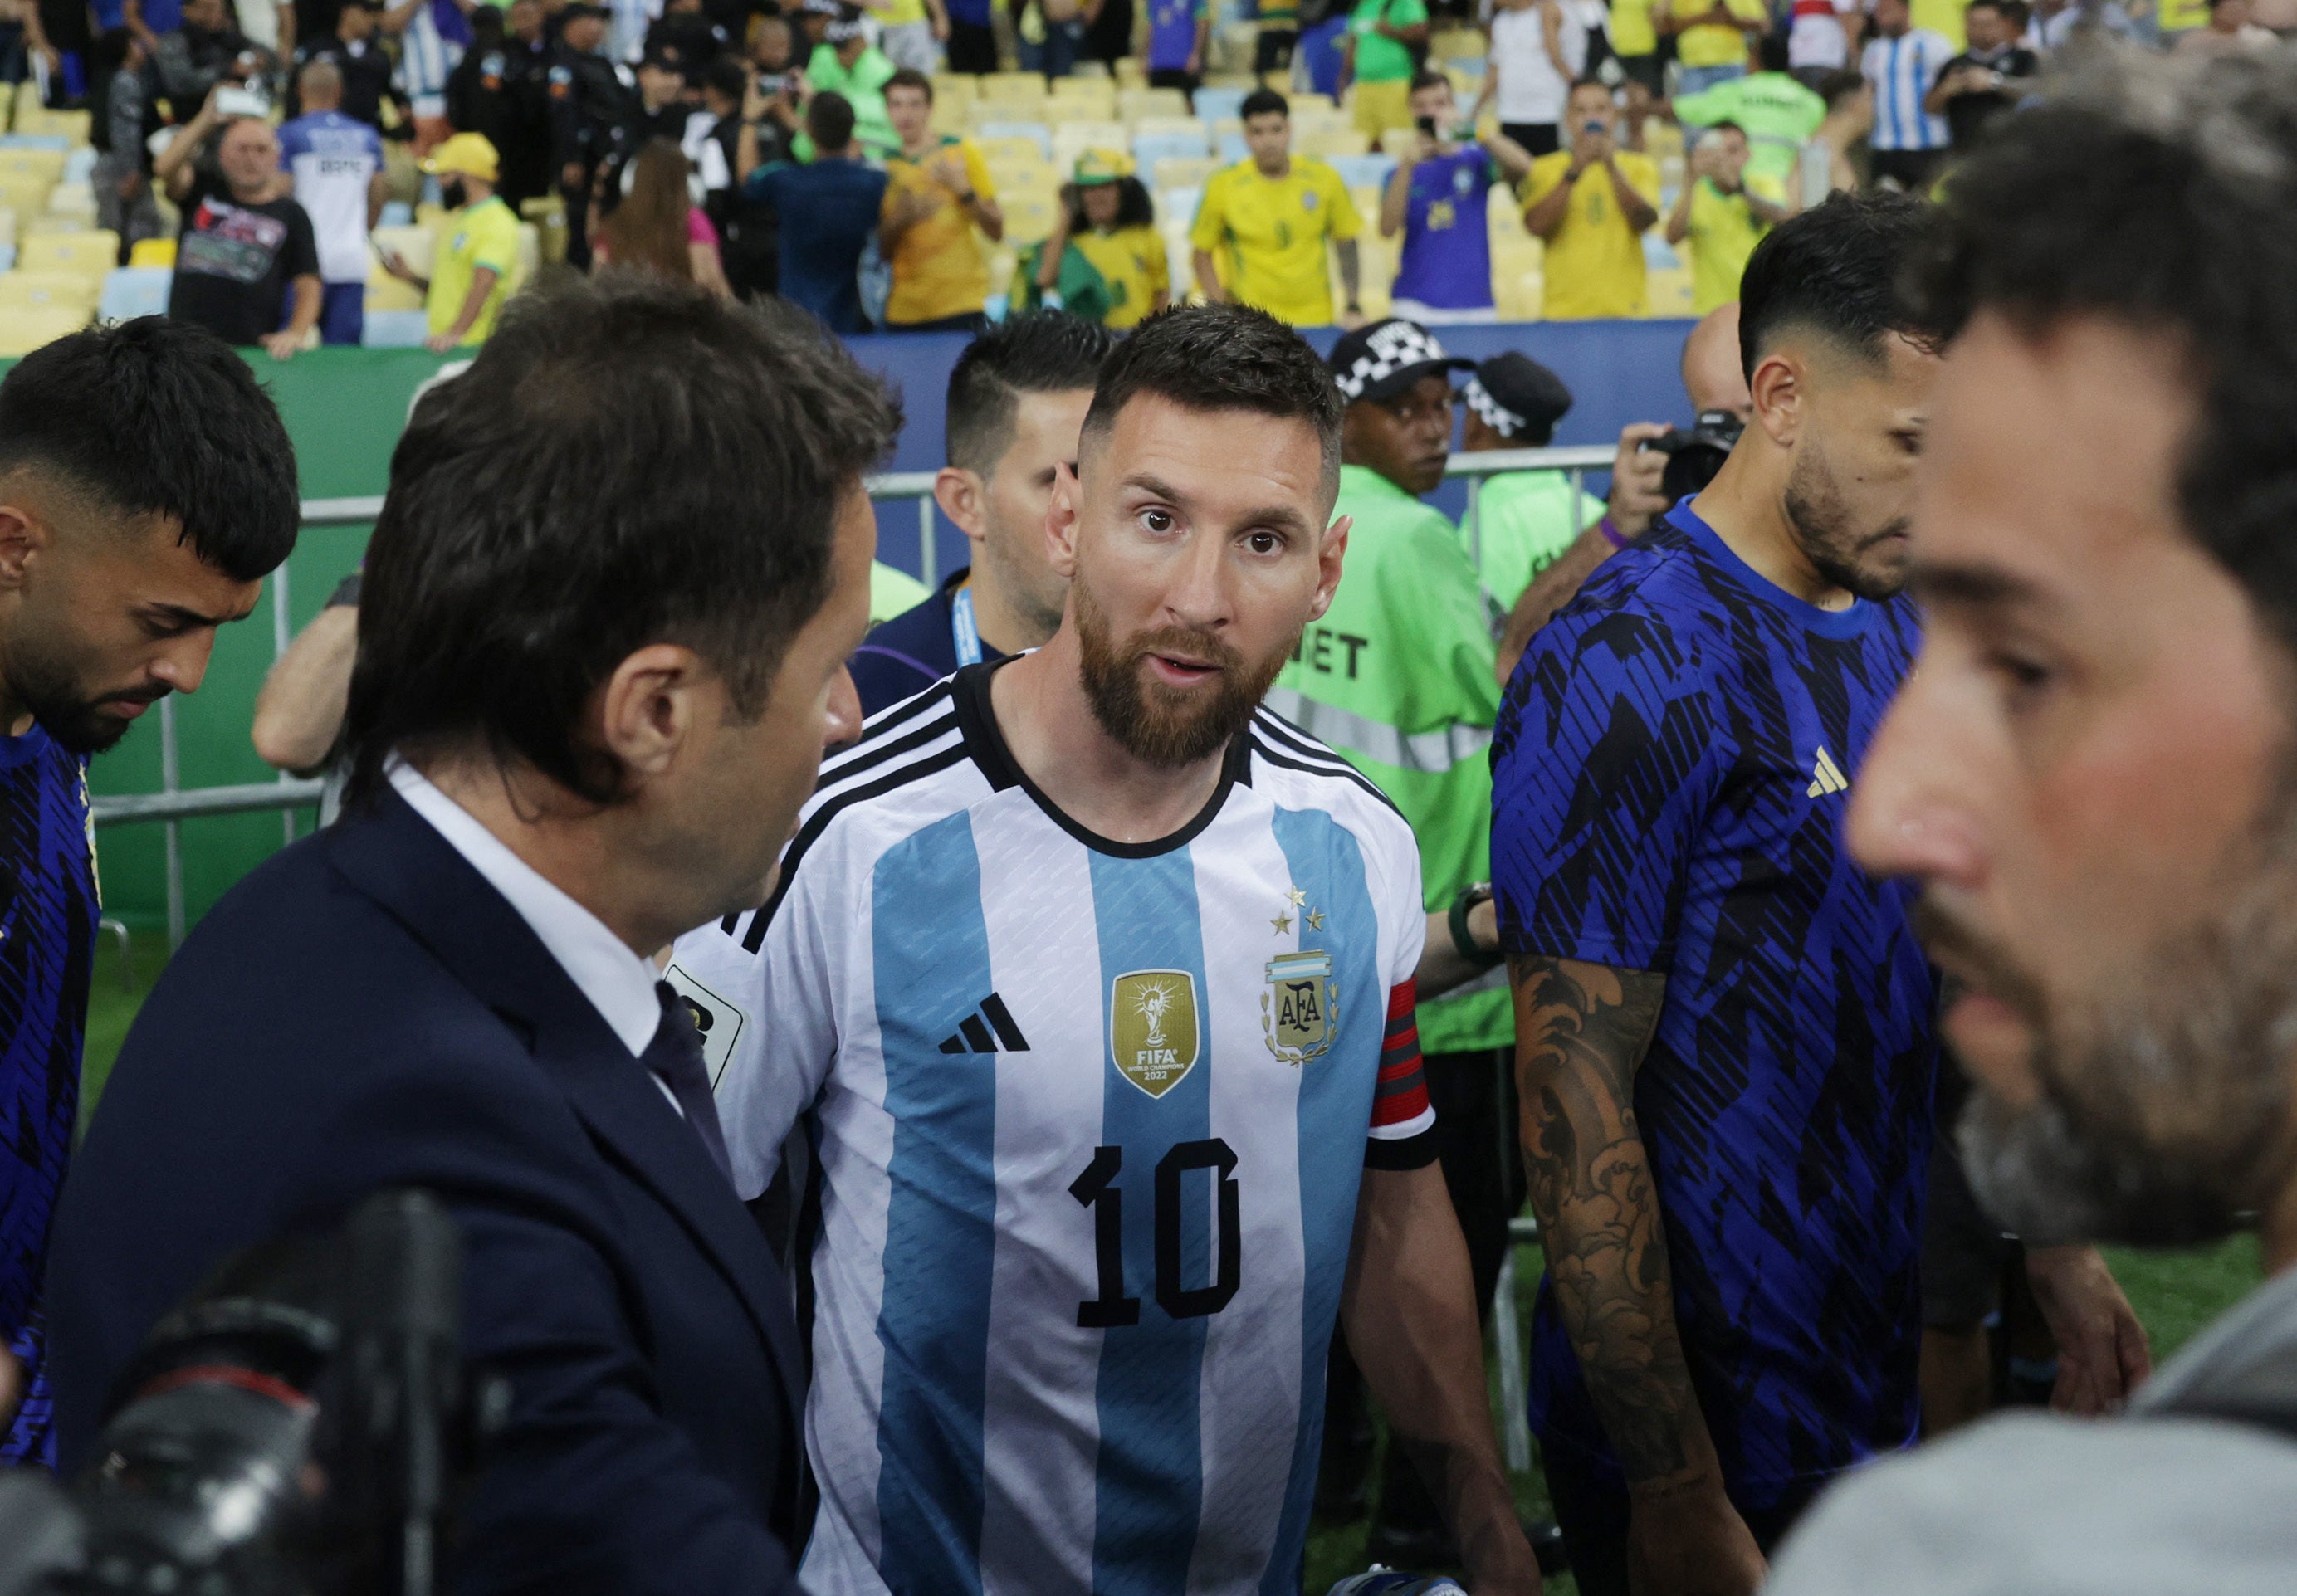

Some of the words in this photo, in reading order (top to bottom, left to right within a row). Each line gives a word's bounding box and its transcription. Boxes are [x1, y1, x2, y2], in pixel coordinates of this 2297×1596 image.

[1279, 981, 1321, 1032] AFA
[1144, 1071, 1166, 1080] 2022
[1068, 1138, 1241, 1327] 10
